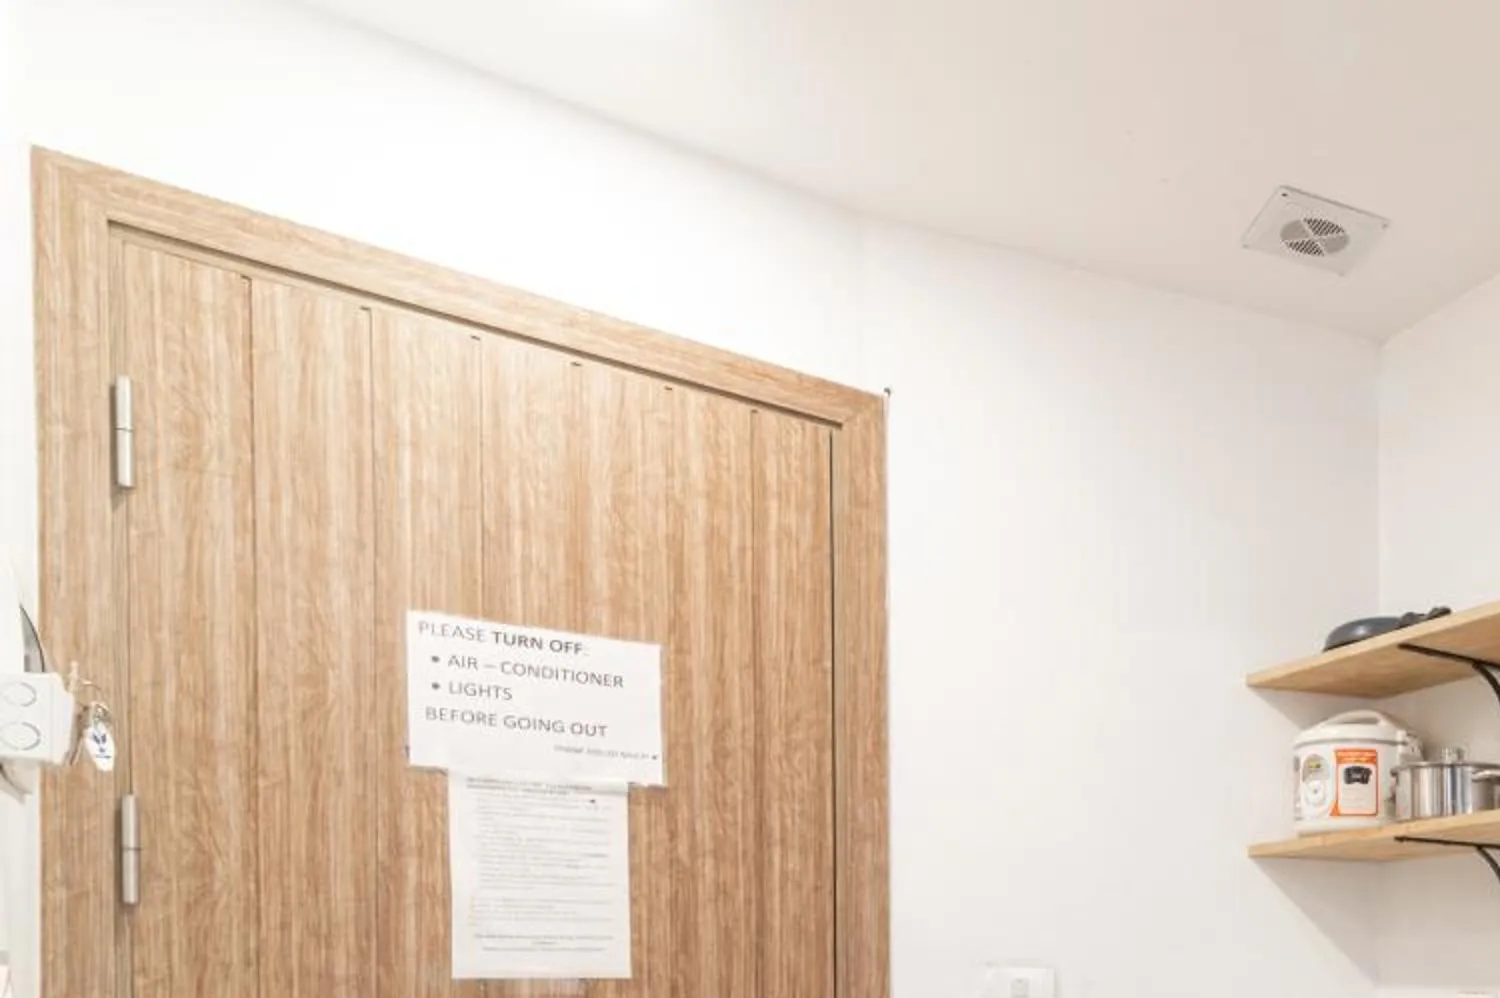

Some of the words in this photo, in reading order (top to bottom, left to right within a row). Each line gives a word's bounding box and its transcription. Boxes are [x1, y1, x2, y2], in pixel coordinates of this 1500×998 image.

[418, 620, 487, 643] PLEASE
[491, 630, 543, 651] TURN
[447, 654, 479, 671] AIR
[500, 660, 624, 689] CONDITIONER
[448, 682, 513, 701] LIGHTS
[425, 706, 498, 727] BEFORE
[503, 715, 566, 734] GOING
[570, 722, 609, 738] OUT
